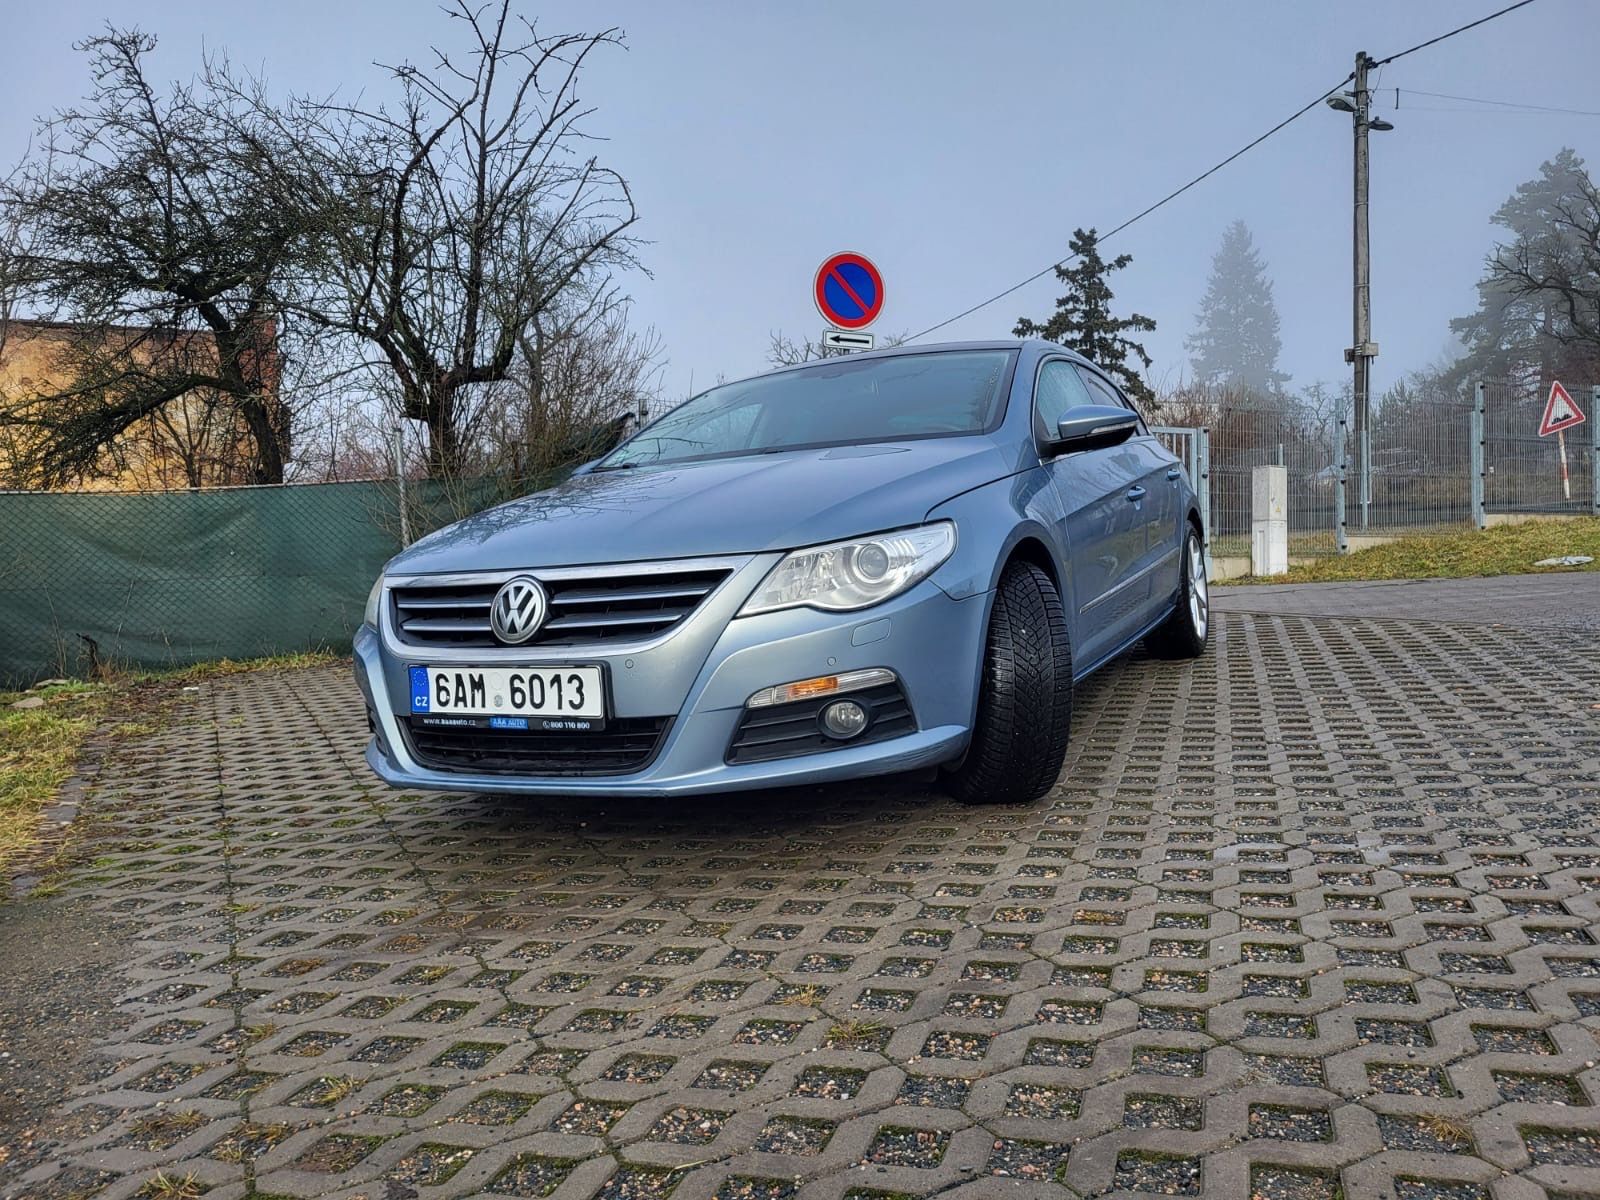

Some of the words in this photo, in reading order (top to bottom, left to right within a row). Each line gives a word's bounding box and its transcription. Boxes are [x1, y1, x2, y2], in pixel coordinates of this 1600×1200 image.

[435, 673, 486, 709] 6AM
[509, 673, 585, 710] 6013
[415, 696, 428, 707] CZ
[508, 718, 526, 729] AUTO
[564, 721, 576, 729] 110
